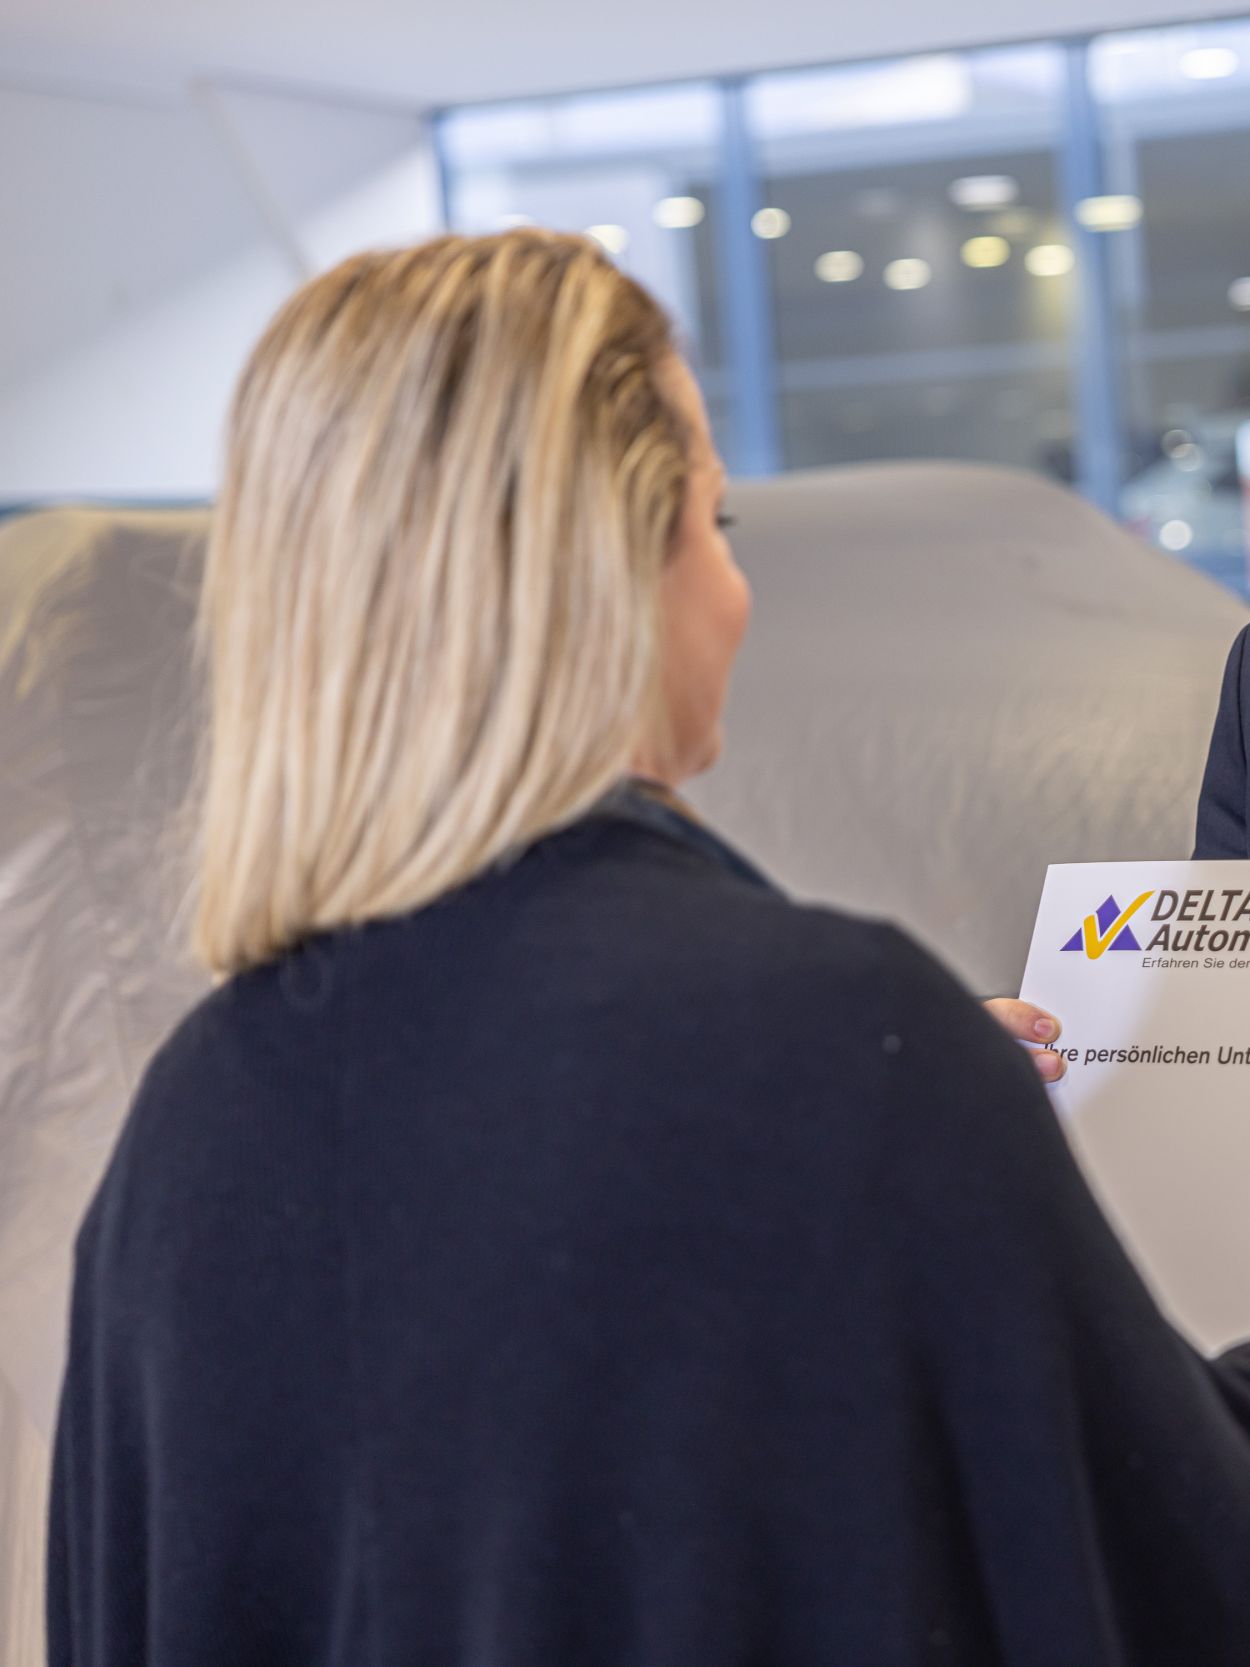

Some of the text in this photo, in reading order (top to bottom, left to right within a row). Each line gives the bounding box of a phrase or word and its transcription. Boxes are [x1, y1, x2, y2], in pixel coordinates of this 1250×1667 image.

[1141, 957, 1199, 969] Erfahren
[1203, 957, 1225, 969] Sie
[1084, 1045, 1211, 1067] persönlichen
